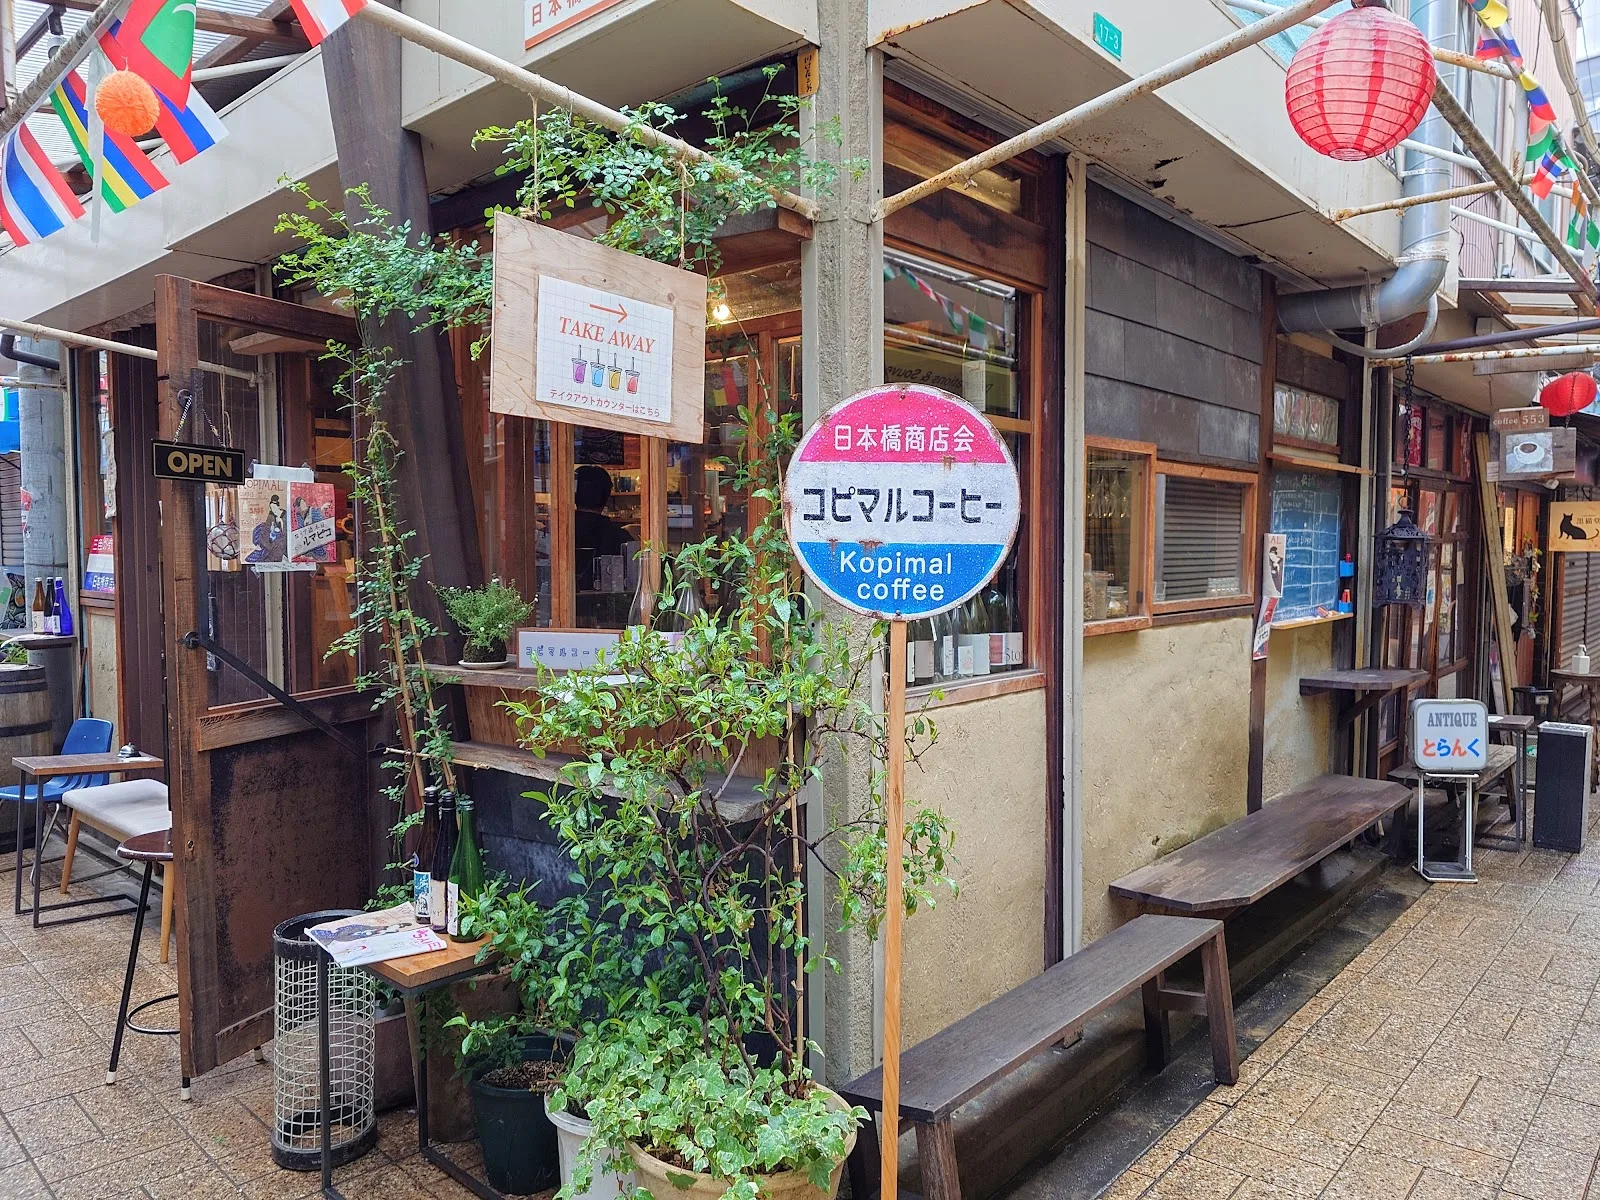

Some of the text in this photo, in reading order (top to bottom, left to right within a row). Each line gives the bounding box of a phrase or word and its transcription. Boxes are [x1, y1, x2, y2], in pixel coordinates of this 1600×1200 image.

[1100, 23, 1119, 50] 17-3
[559, 316, 656, 354] TAKE AWAY
[550, 389, 661, 418] テイクアウトカウンターはこちら
[1493, 414, 1546, 427] coffee 553
[833, 423, 975, 453] 日本橋商店会
[167, 450, 233, 478] OPEN
[802, 486, 1002, 524] コピマルコーヒー
[840, 551, 952, 579] Kopimal
[857, 577, 945, 601] coffee
[1427, 712, 1478, 728] ANTIQUE
[1422, 738, 1480, 758] とらんく
